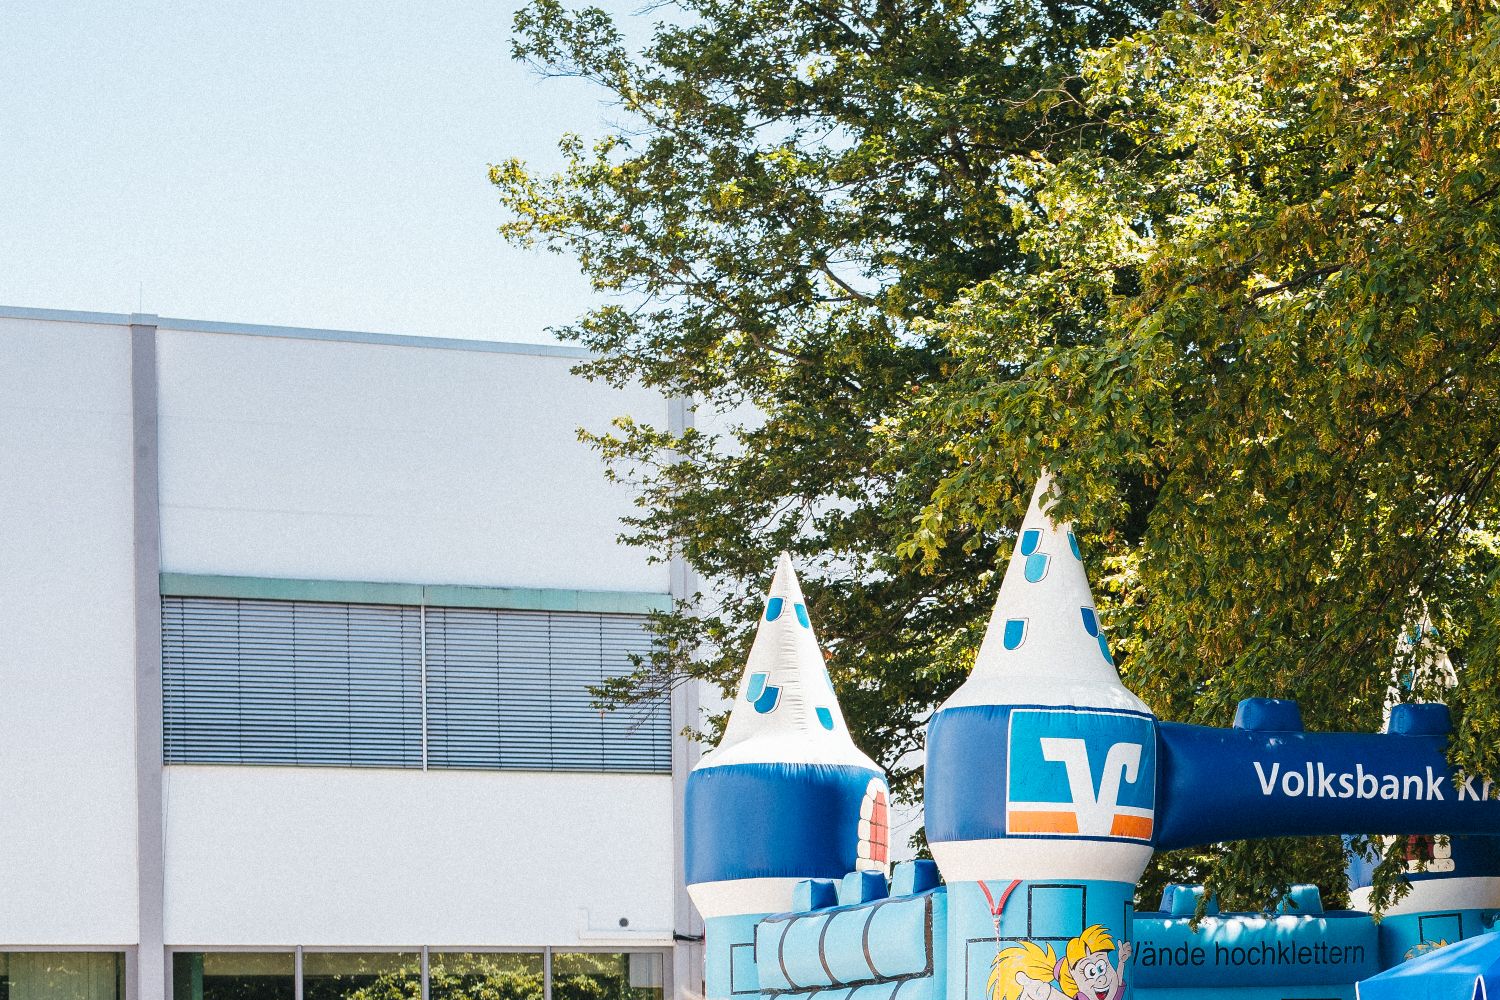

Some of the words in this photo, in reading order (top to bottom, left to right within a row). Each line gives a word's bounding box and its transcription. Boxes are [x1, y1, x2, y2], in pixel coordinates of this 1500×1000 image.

[1253, 761, 1445, 801] Volksbank
[1132, 941, 1205, 966] ände
[1215, 941, 1365, 966] hochklettern
